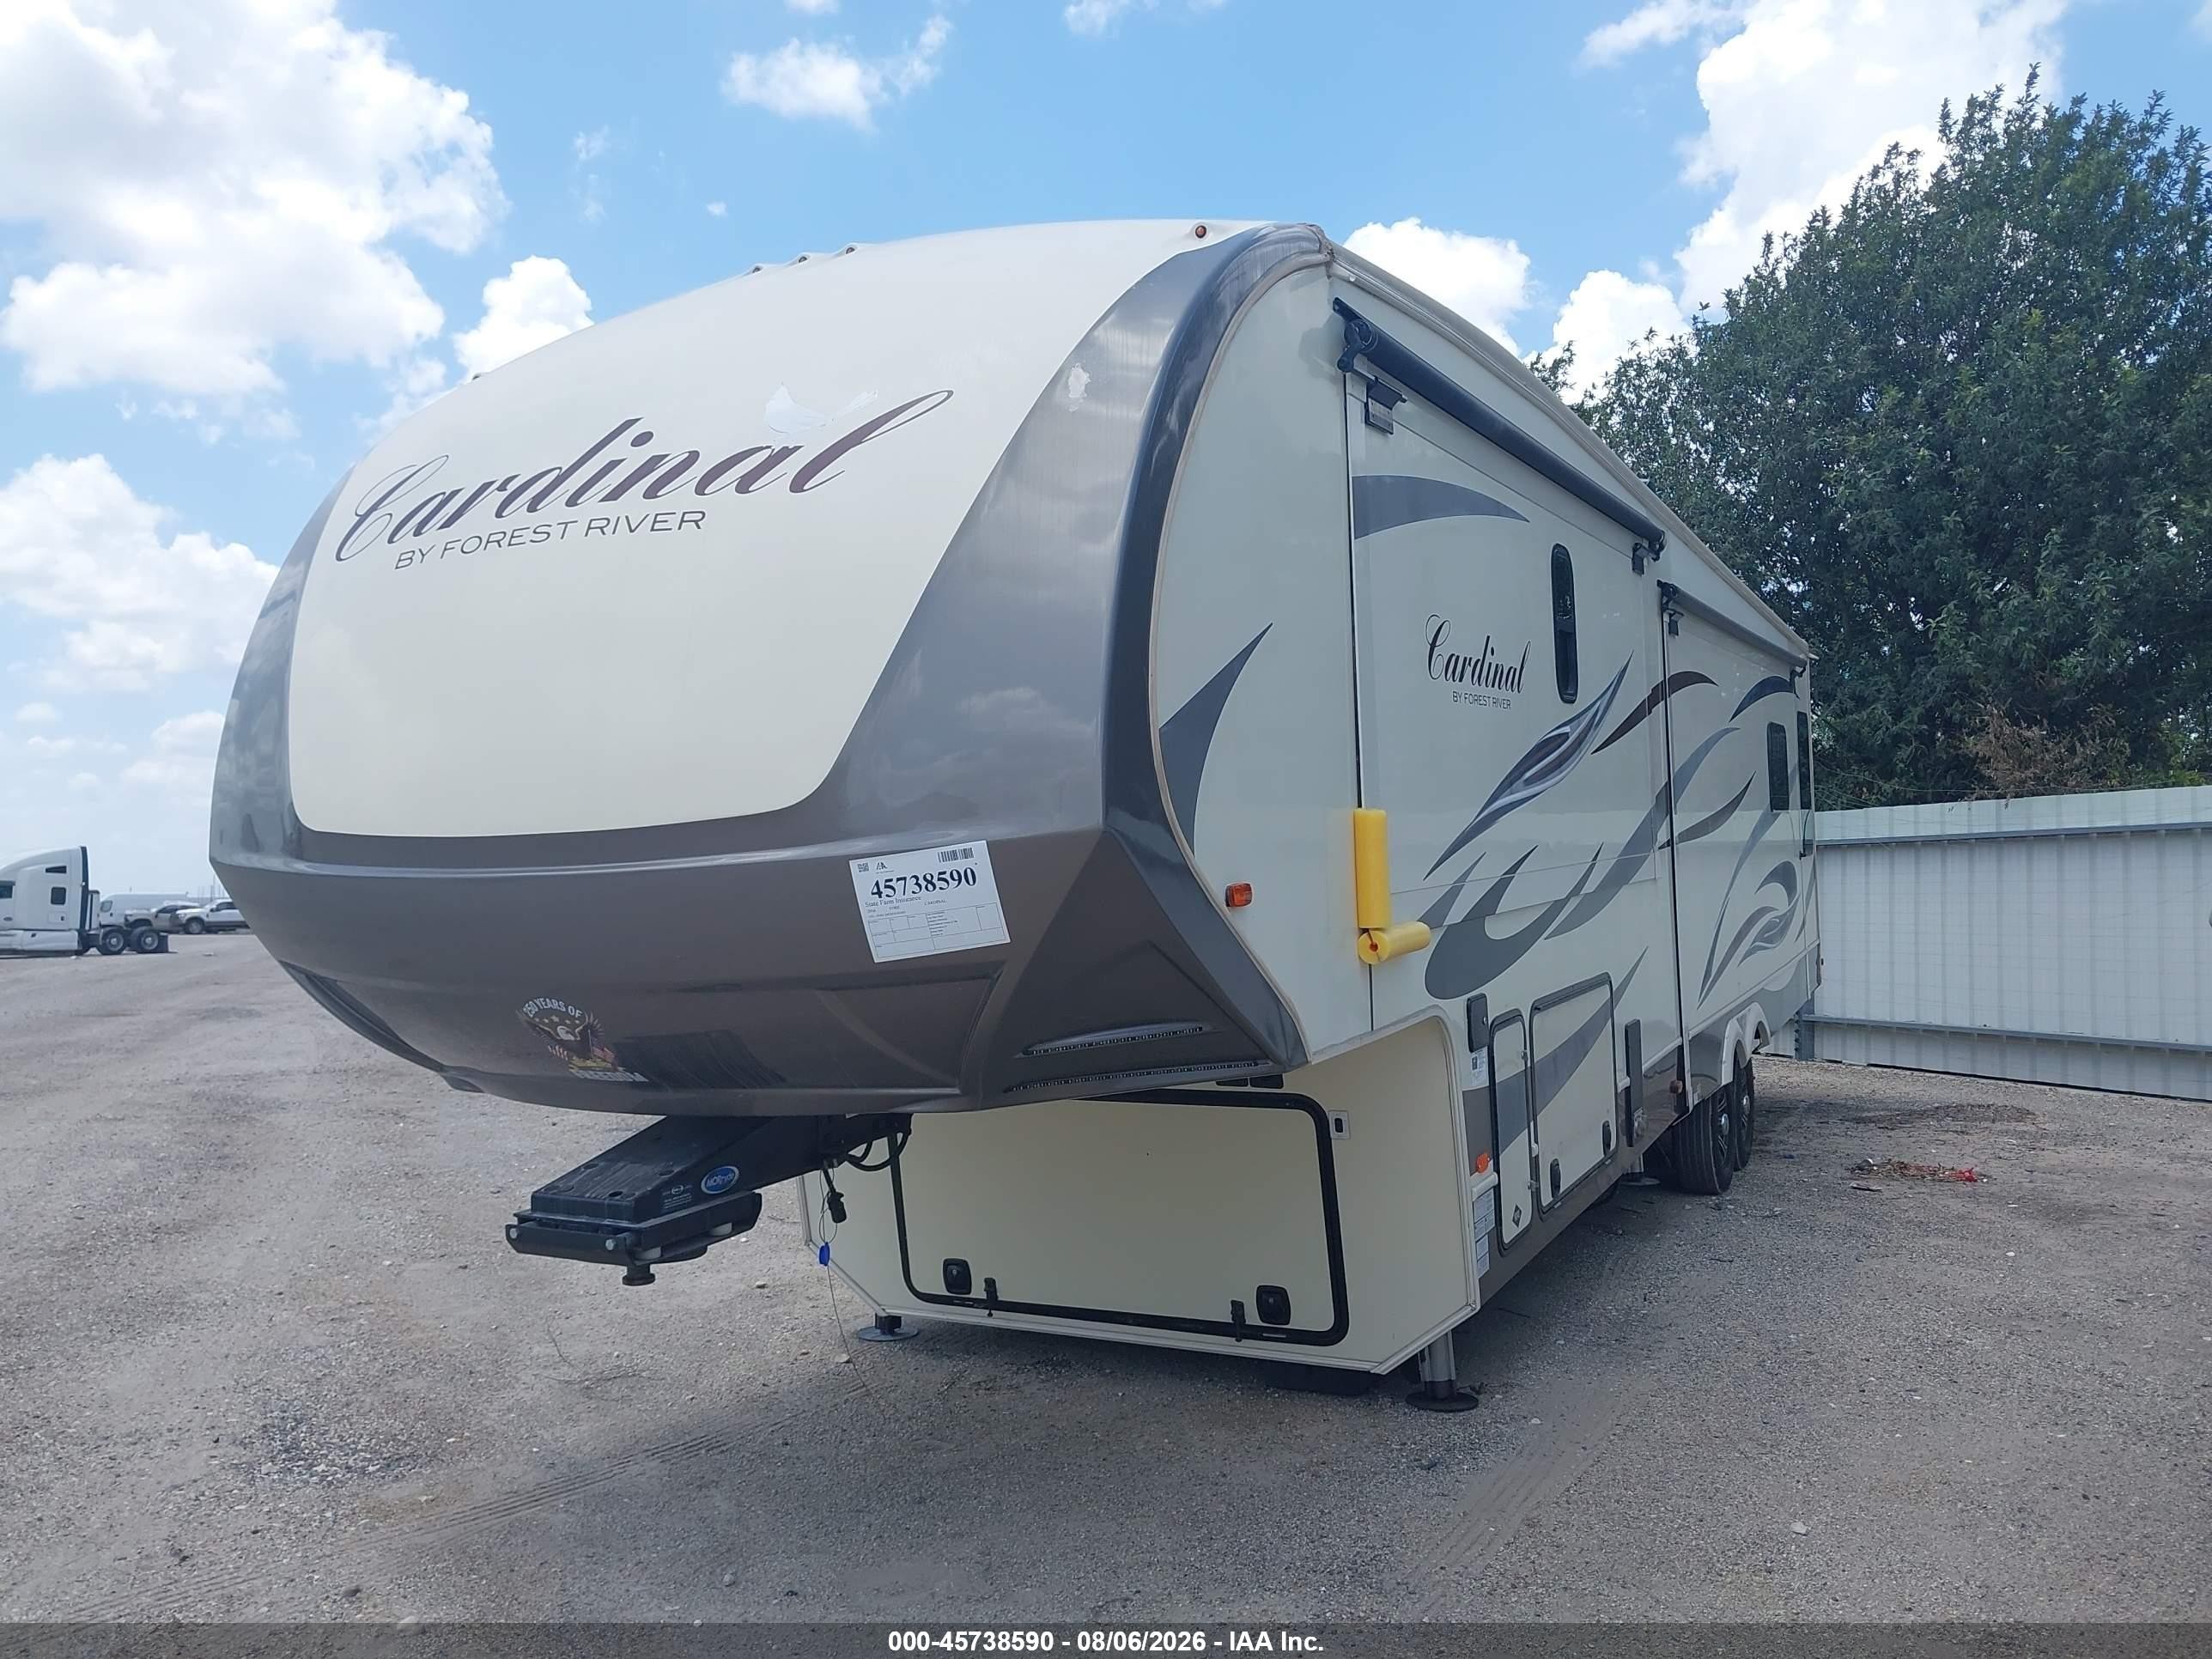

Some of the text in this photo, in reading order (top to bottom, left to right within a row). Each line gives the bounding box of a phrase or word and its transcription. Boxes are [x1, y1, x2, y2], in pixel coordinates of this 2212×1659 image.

[335, 389, 954, 562] Cardinal
[394, 510, 707, 570] BY FOREST RIVER
[1425, 614, 1531, 695] Cardinal
[1452, 690, 1511, 710] BY FOREST RIVER
[871, 866, 977, 899] 45738590
[523, 997, 583, 1018] 250 YEARS OF
